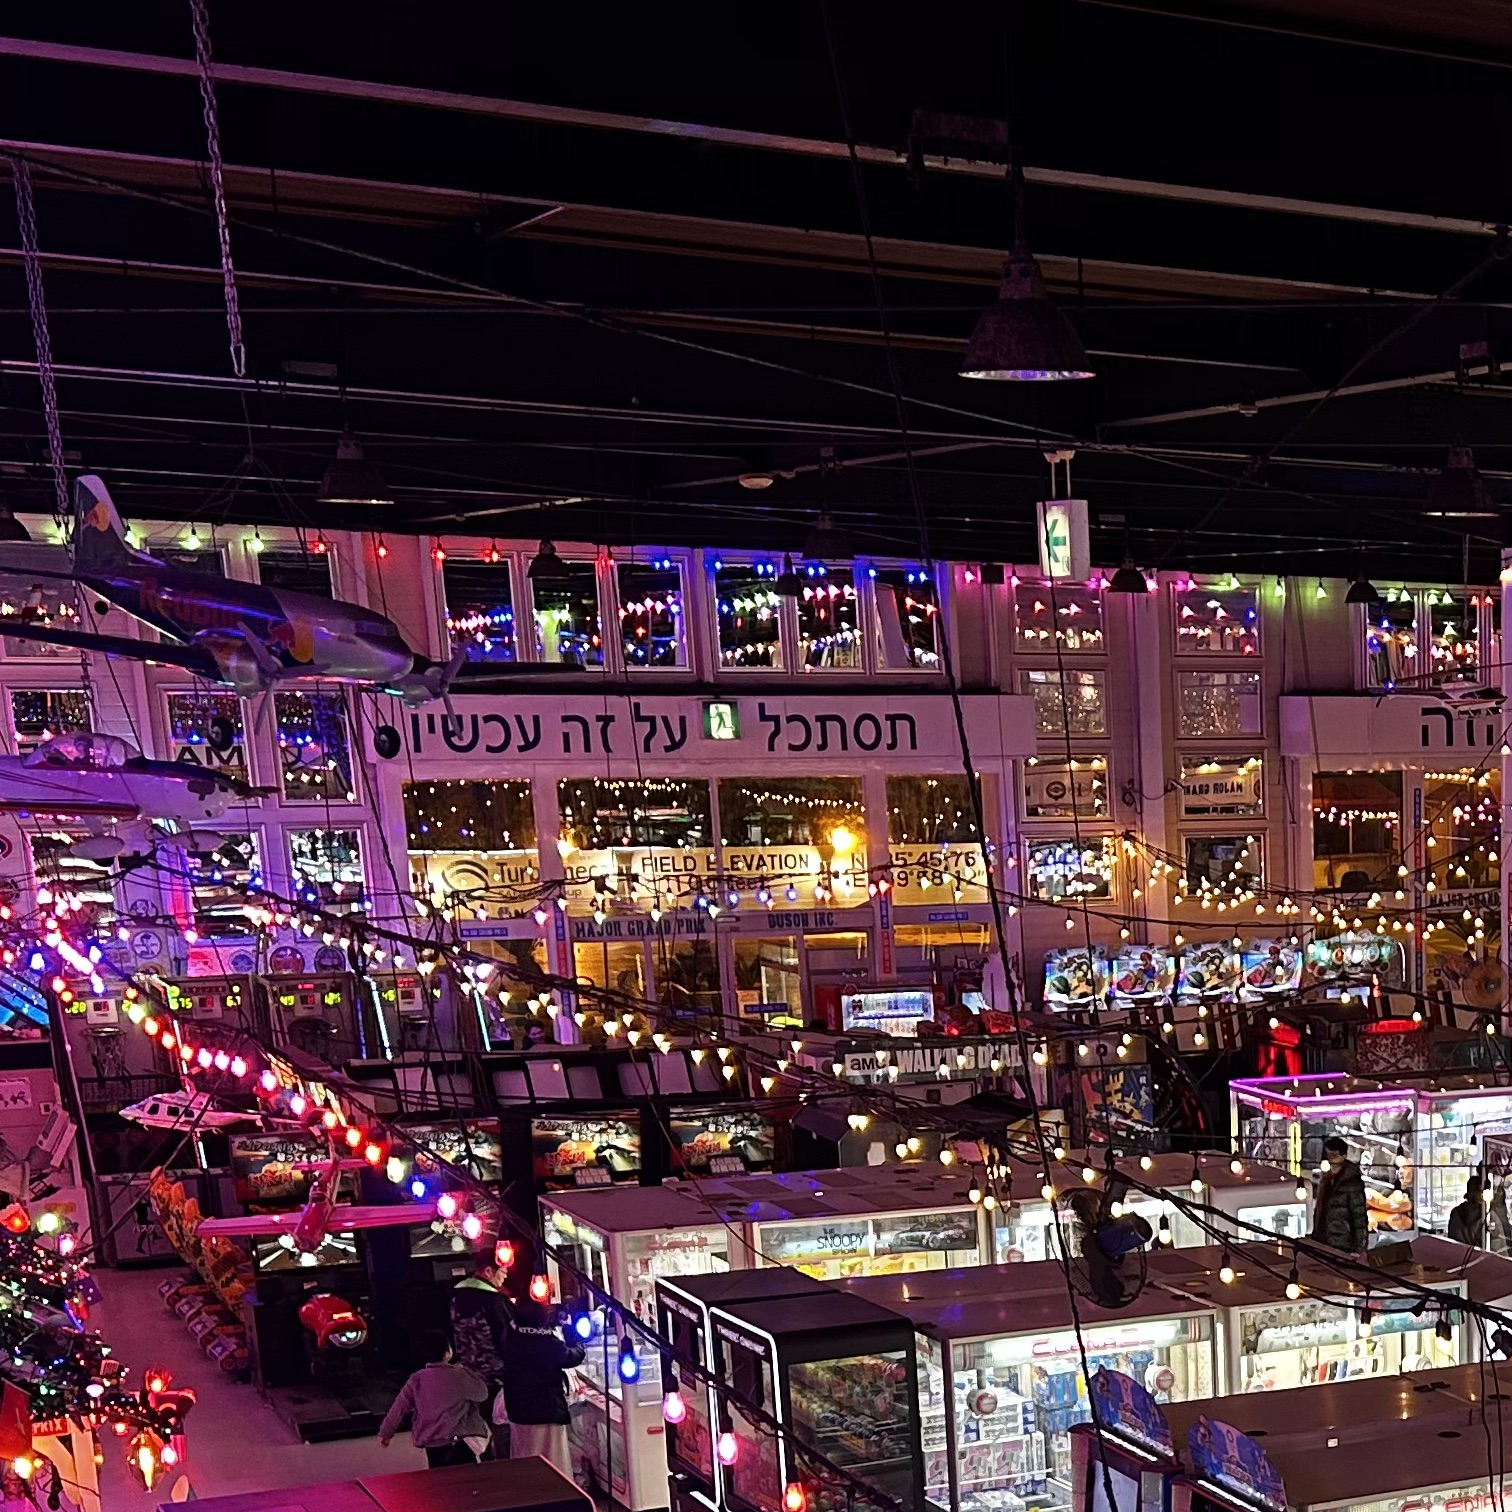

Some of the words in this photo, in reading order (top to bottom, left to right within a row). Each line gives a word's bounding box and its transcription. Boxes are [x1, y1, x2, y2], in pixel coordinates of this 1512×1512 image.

[561, 714, 616, 753] זה
[633, 702, 688, 753] על
[758, 702, 918, 751] תסתכל
[641, 854, 697, 873] FIELD
[817, 1232, 866, 1249] SNOOPY
